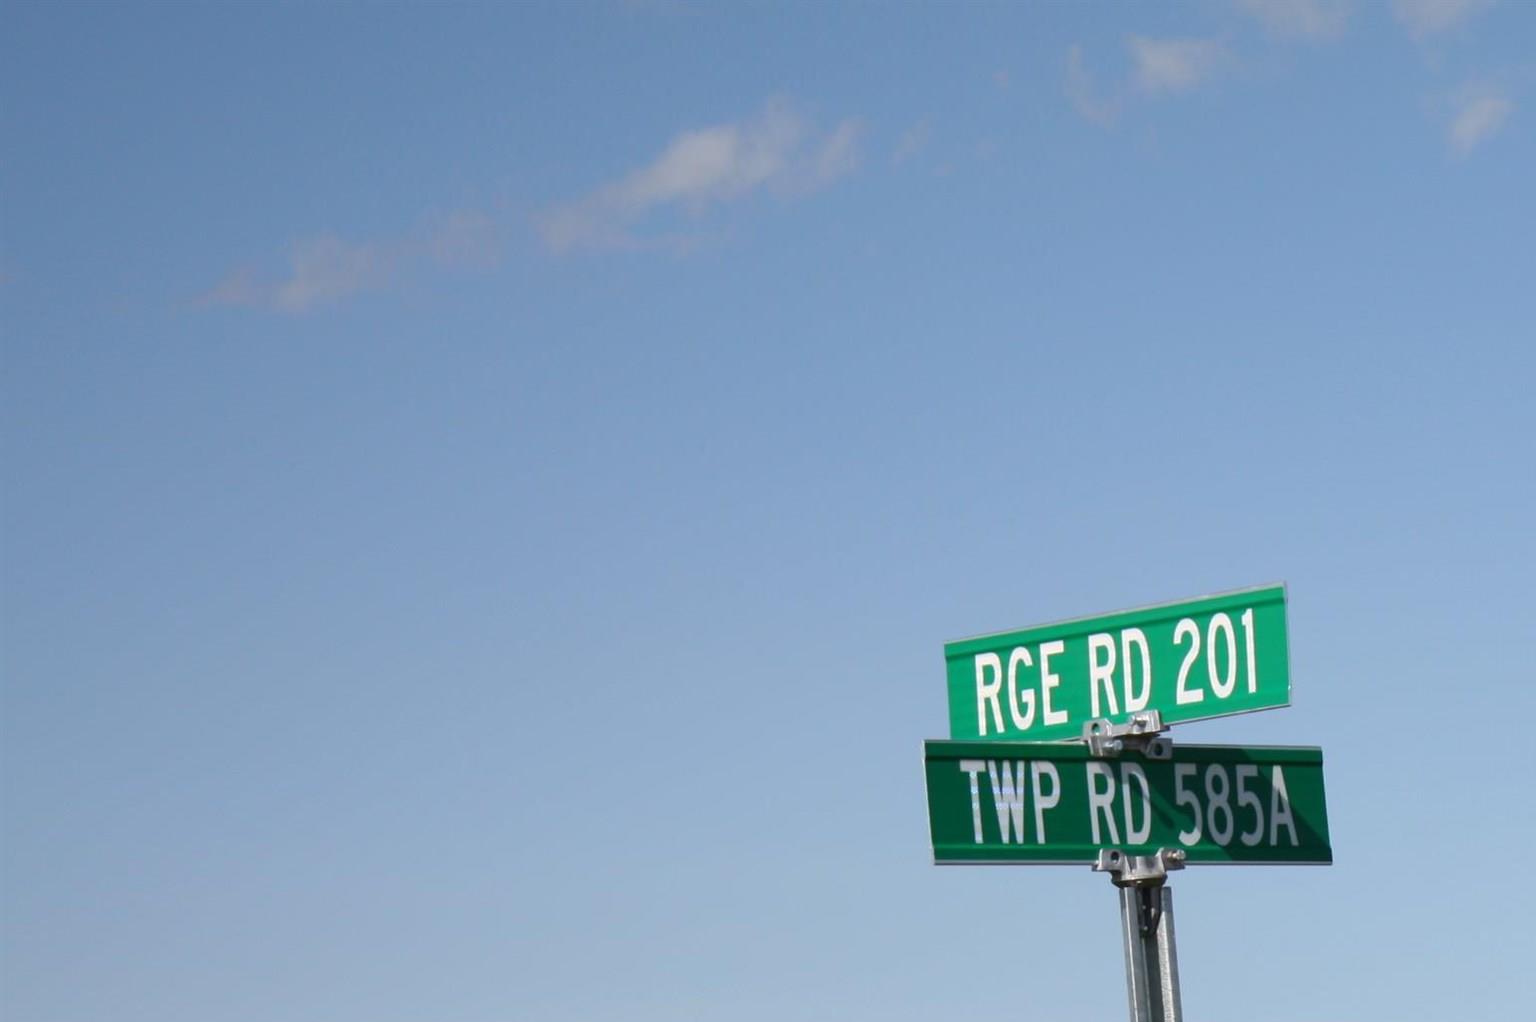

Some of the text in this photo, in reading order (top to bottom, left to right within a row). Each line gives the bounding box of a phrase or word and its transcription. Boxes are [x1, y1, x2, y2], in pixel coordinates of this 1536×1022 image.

[974, 608, 1257, 736] RGE RD 201
[959, 760, 1299, 847] TWP RD 585A
